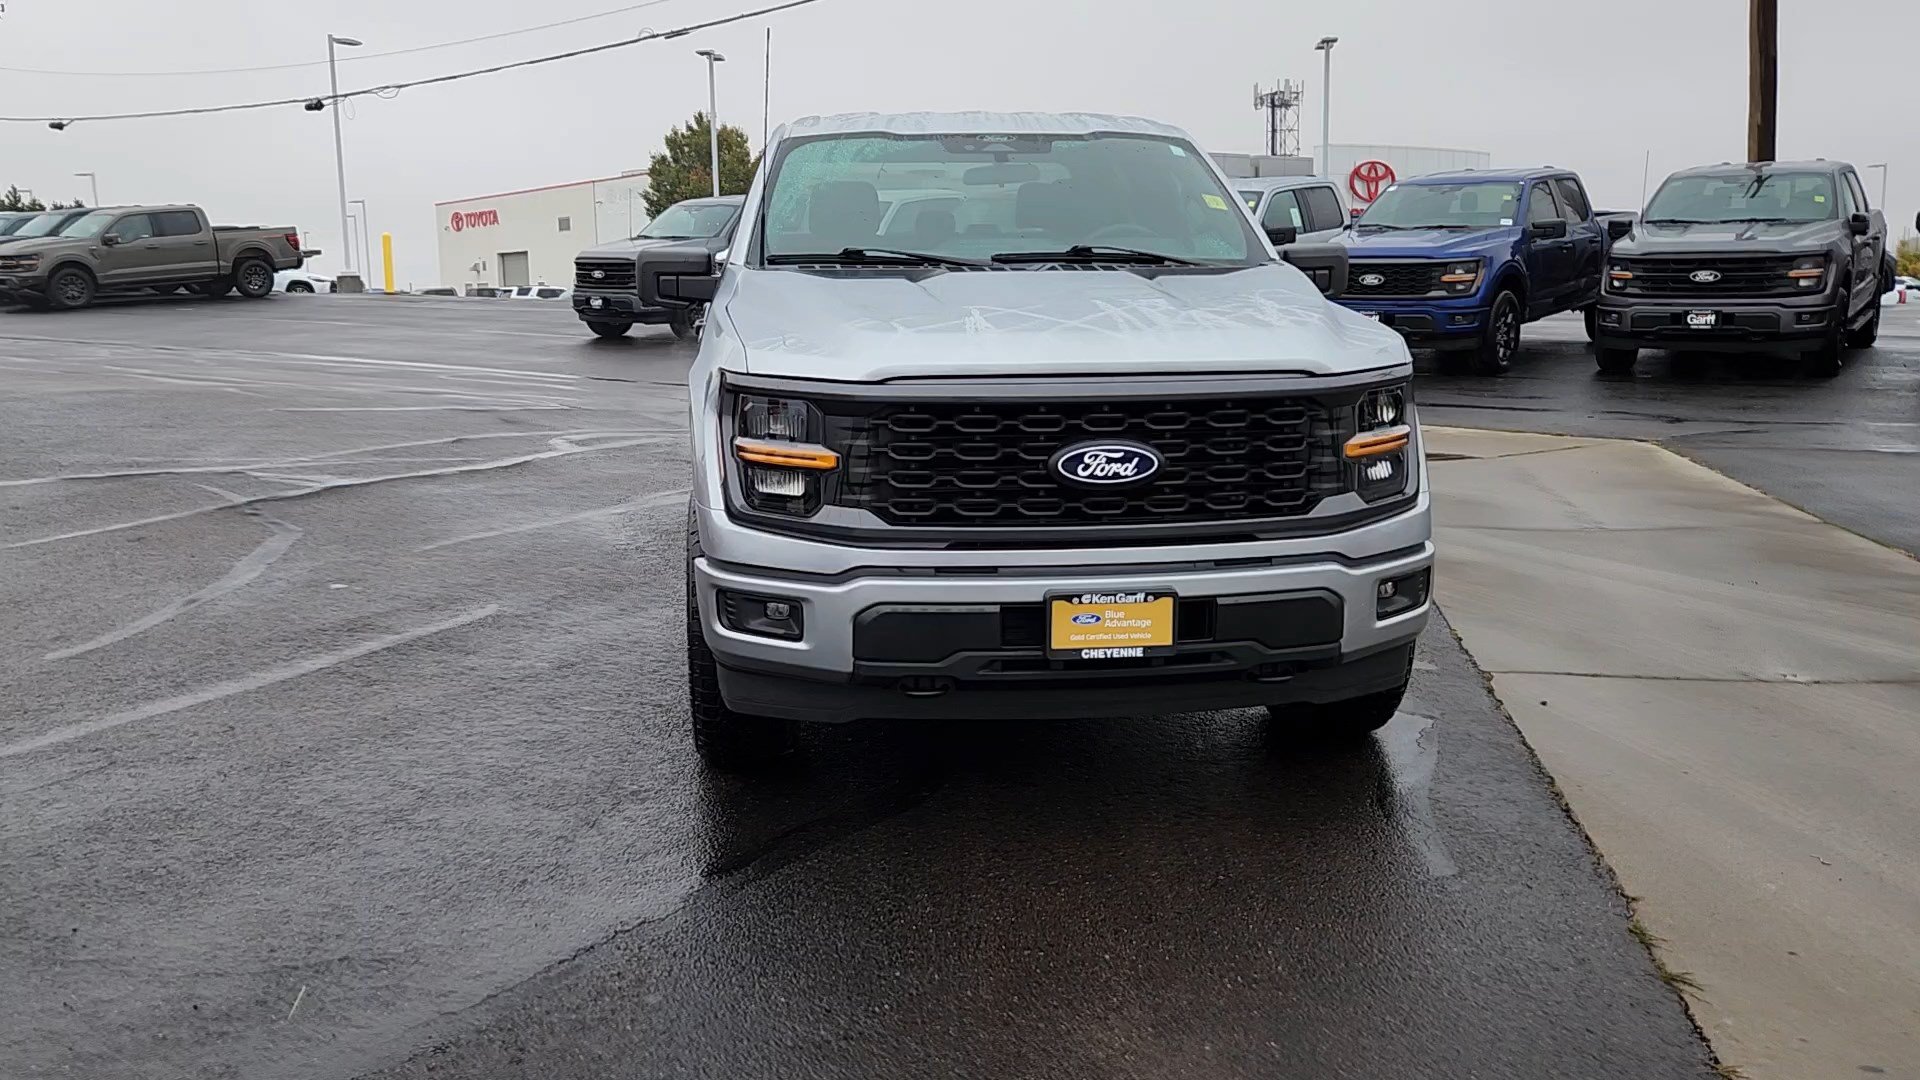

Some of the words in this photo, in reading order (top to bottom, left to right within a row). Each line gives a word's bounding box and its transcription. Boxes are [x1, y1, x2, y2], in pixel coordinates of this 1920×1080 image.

[464, 209, 500, 228] TOYOTA
[1077, 451, 1139, 477] Ford
[1092, 593, 1115, 604] Ken
[1116, 592, 1146, 604] Garff
[1105, 610, 1125, 619] Blue
[1104, 619, 1152, 629] Advantage
[1070, 633, 1085, 641] Gold
[1086, 632, 1112, 641] Certified
[1112, 632, 1129, 640] Used
[1081, 647, 1144, 659] CHEYENNE
